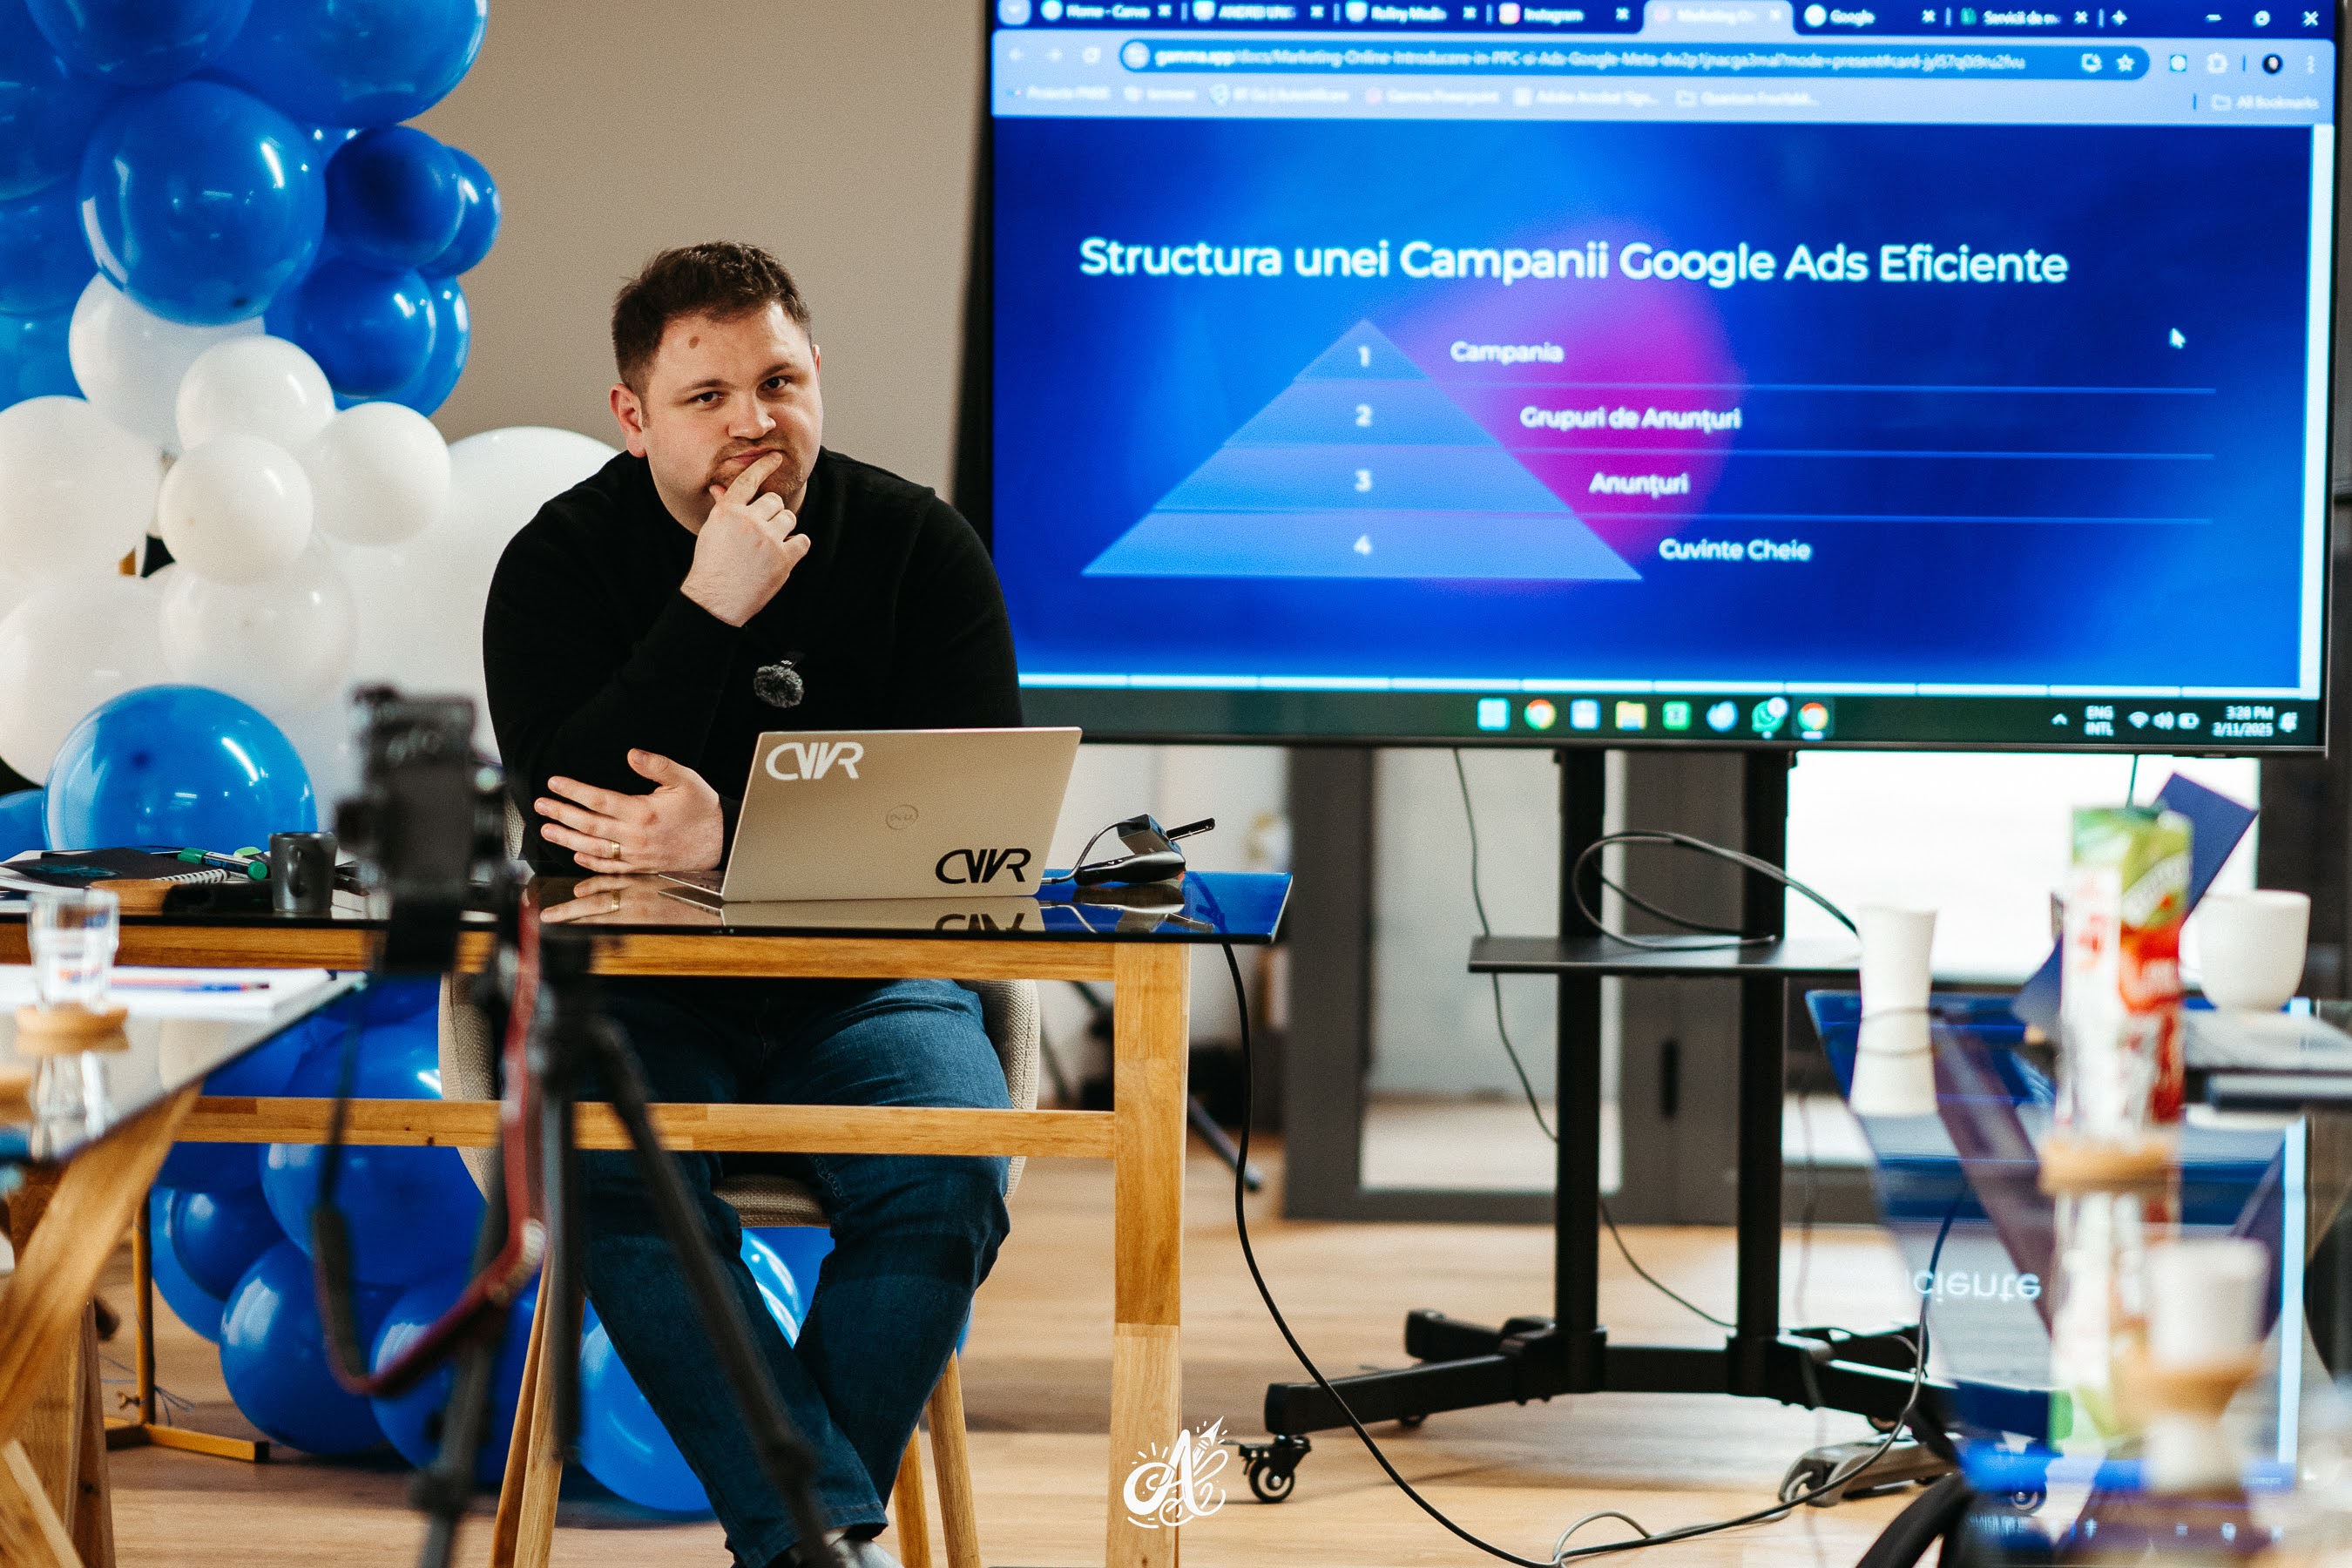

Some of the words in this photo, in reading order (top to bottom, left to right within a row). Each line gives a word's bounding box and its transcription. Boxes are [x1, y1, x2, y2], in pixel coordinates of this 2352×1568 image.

[1524, 8, 1585, 24] Instagram
[1830, 10, 1875, 27] Google
[1080, 236, 1283, 279] Structura
[1294, 238, 1389, 279] unei
[1399, 239, 1610, 287] Campanii
[1619, 240, 1777, 289] Google
[1783, 243, 1869, 282] Ads
[1880, 243, 2069, 283] Eficiente
[1357, 343, 1372, 368] 1
[1449, 339, 1566, 367] Campania
[1355, 402, 1374, 428] 2
[1519, 405, 1605, 432] Grupuri
[1607, 406, 1639, 430] de
[1355, 469, 1373, 494] 3
[1353, 534, 1373, 557] 4
[1658, 537, 1744, 563] Cuvinte
[1747, 538, 1813, 563] Cheie
[2085, 705, 2114, 720] ENG
[2253, 705, 2274, 720] PM
[2085, 721, 2114, 737] INTL
